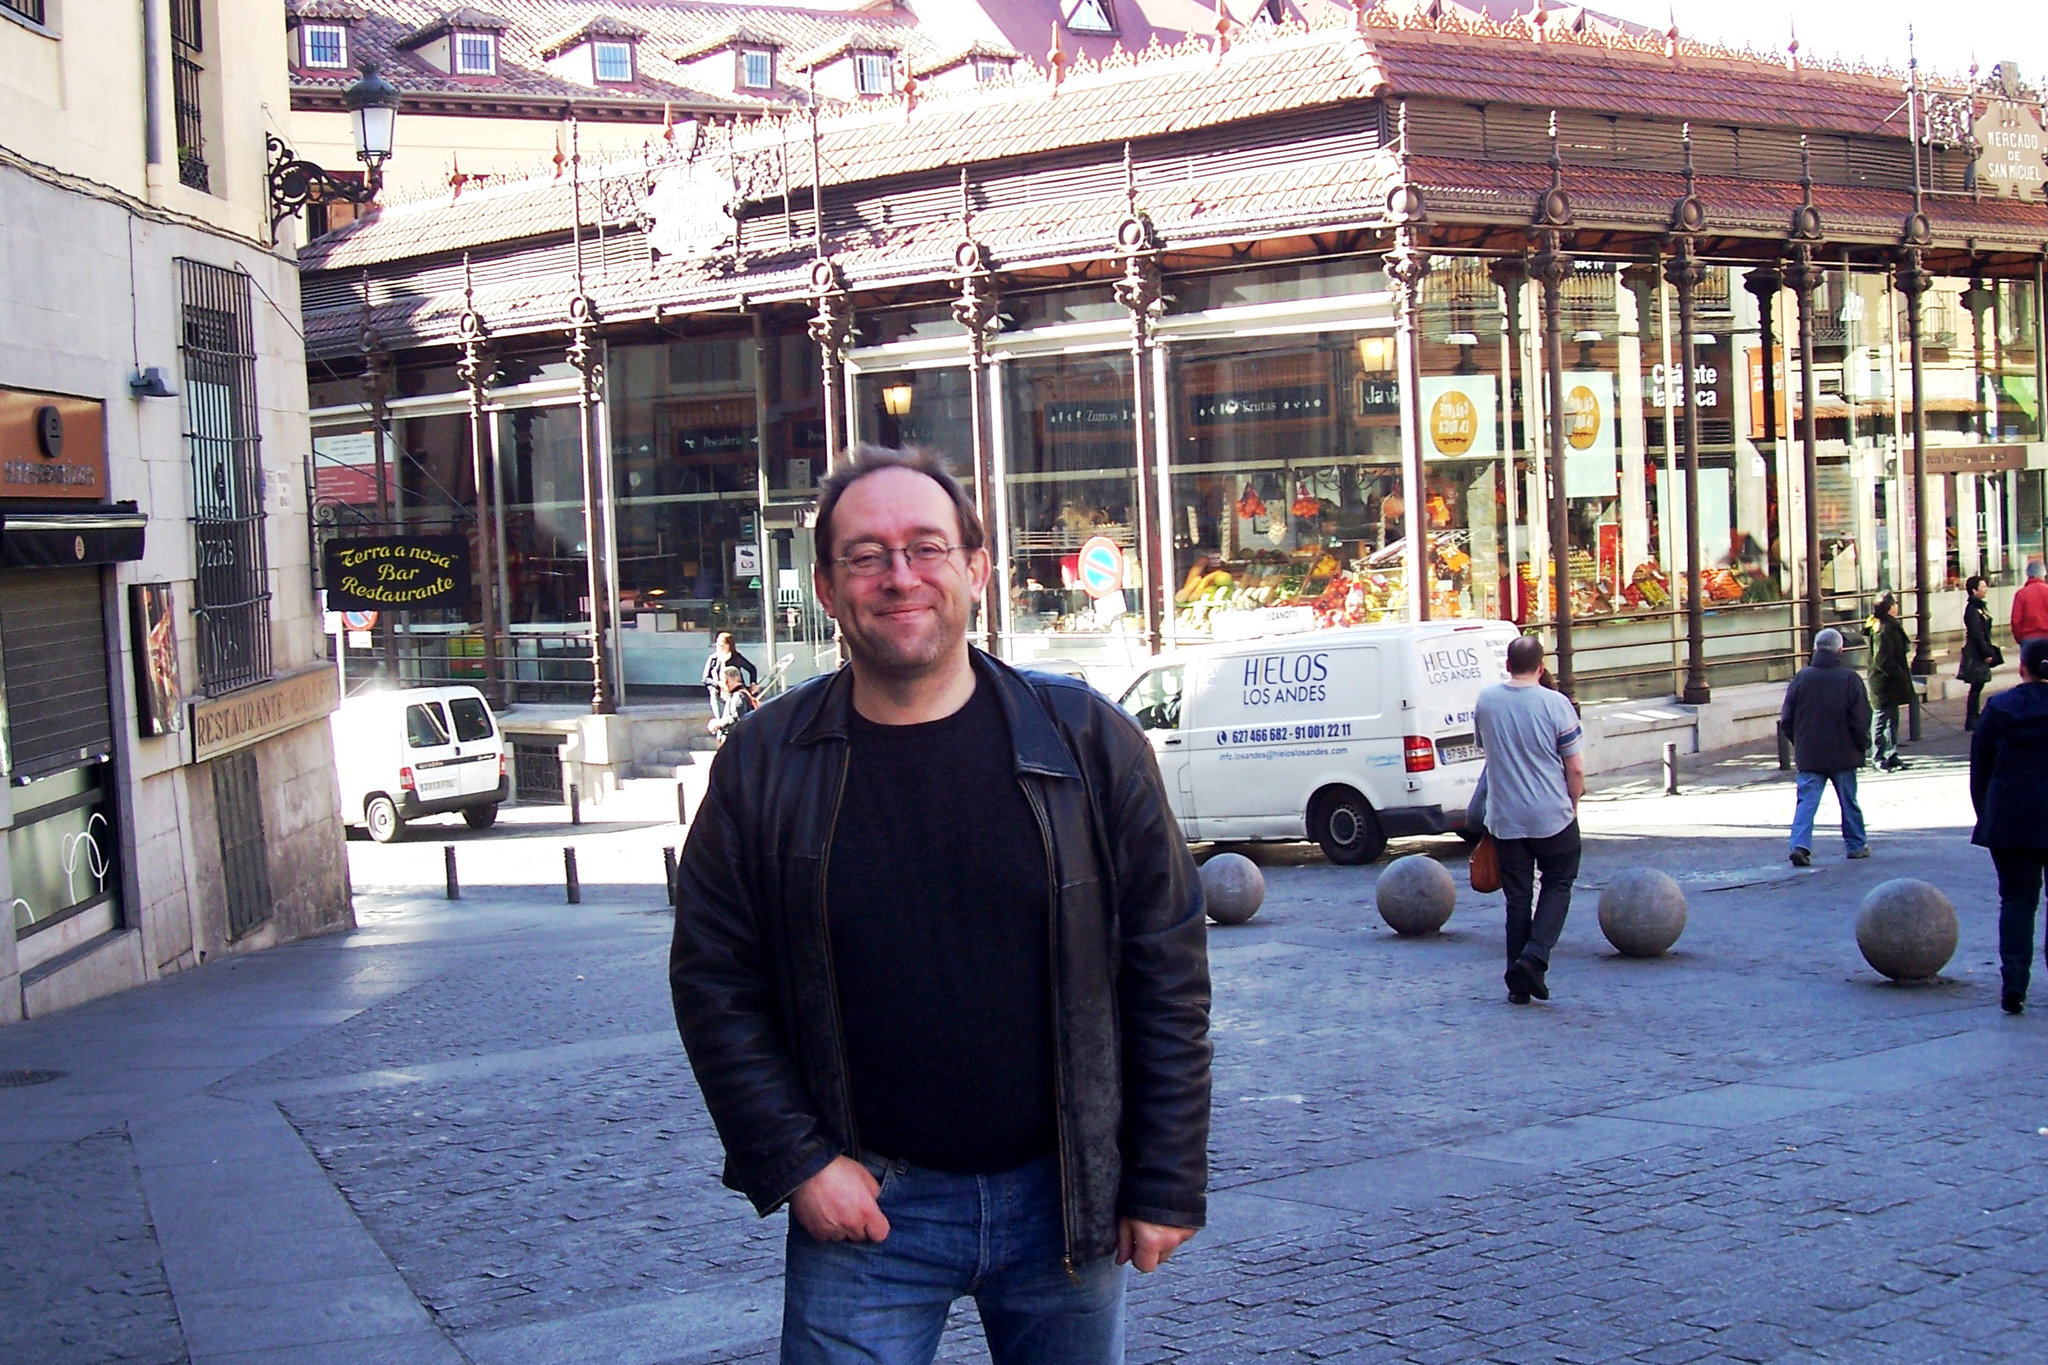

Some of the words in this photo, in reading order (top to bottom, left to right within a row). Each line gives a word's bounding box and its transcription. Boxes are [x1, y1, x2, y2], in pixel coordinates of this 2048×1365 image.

[1987, 131, 2038, 149] MERCADO
[2007, 150, 2021, 161] DE
[1988, 162, 2007, 178] SAN
[394, 545, 405, 557] a
[377, 563, 421, 581] Bar
[341, 575, 455, 602] Restaurante
[1423, 647, 1479, 672] HIELOS
[1243, 652, 1329, 687] HIELOS
[1428, 671, 1449, 685] LOS
[1451, 667, 1482, 681] ANDES
[1243, 688, 1271, 706] LOS
[1274, 684, 1326, 704] ANDES
[197, 690, 285, 747] RESTAURANTE
[1232, 729, 1248, 743] 627
[1249, 728, 1267, 742] 466
[1269, 727, 1288, 741] 682
[1295, 726, 1306, 740] 91
[1307, 725, 1325, 739] 001
[1327, 723, 1339, 737] 22
[1342, 723, 1351, 736] 11
